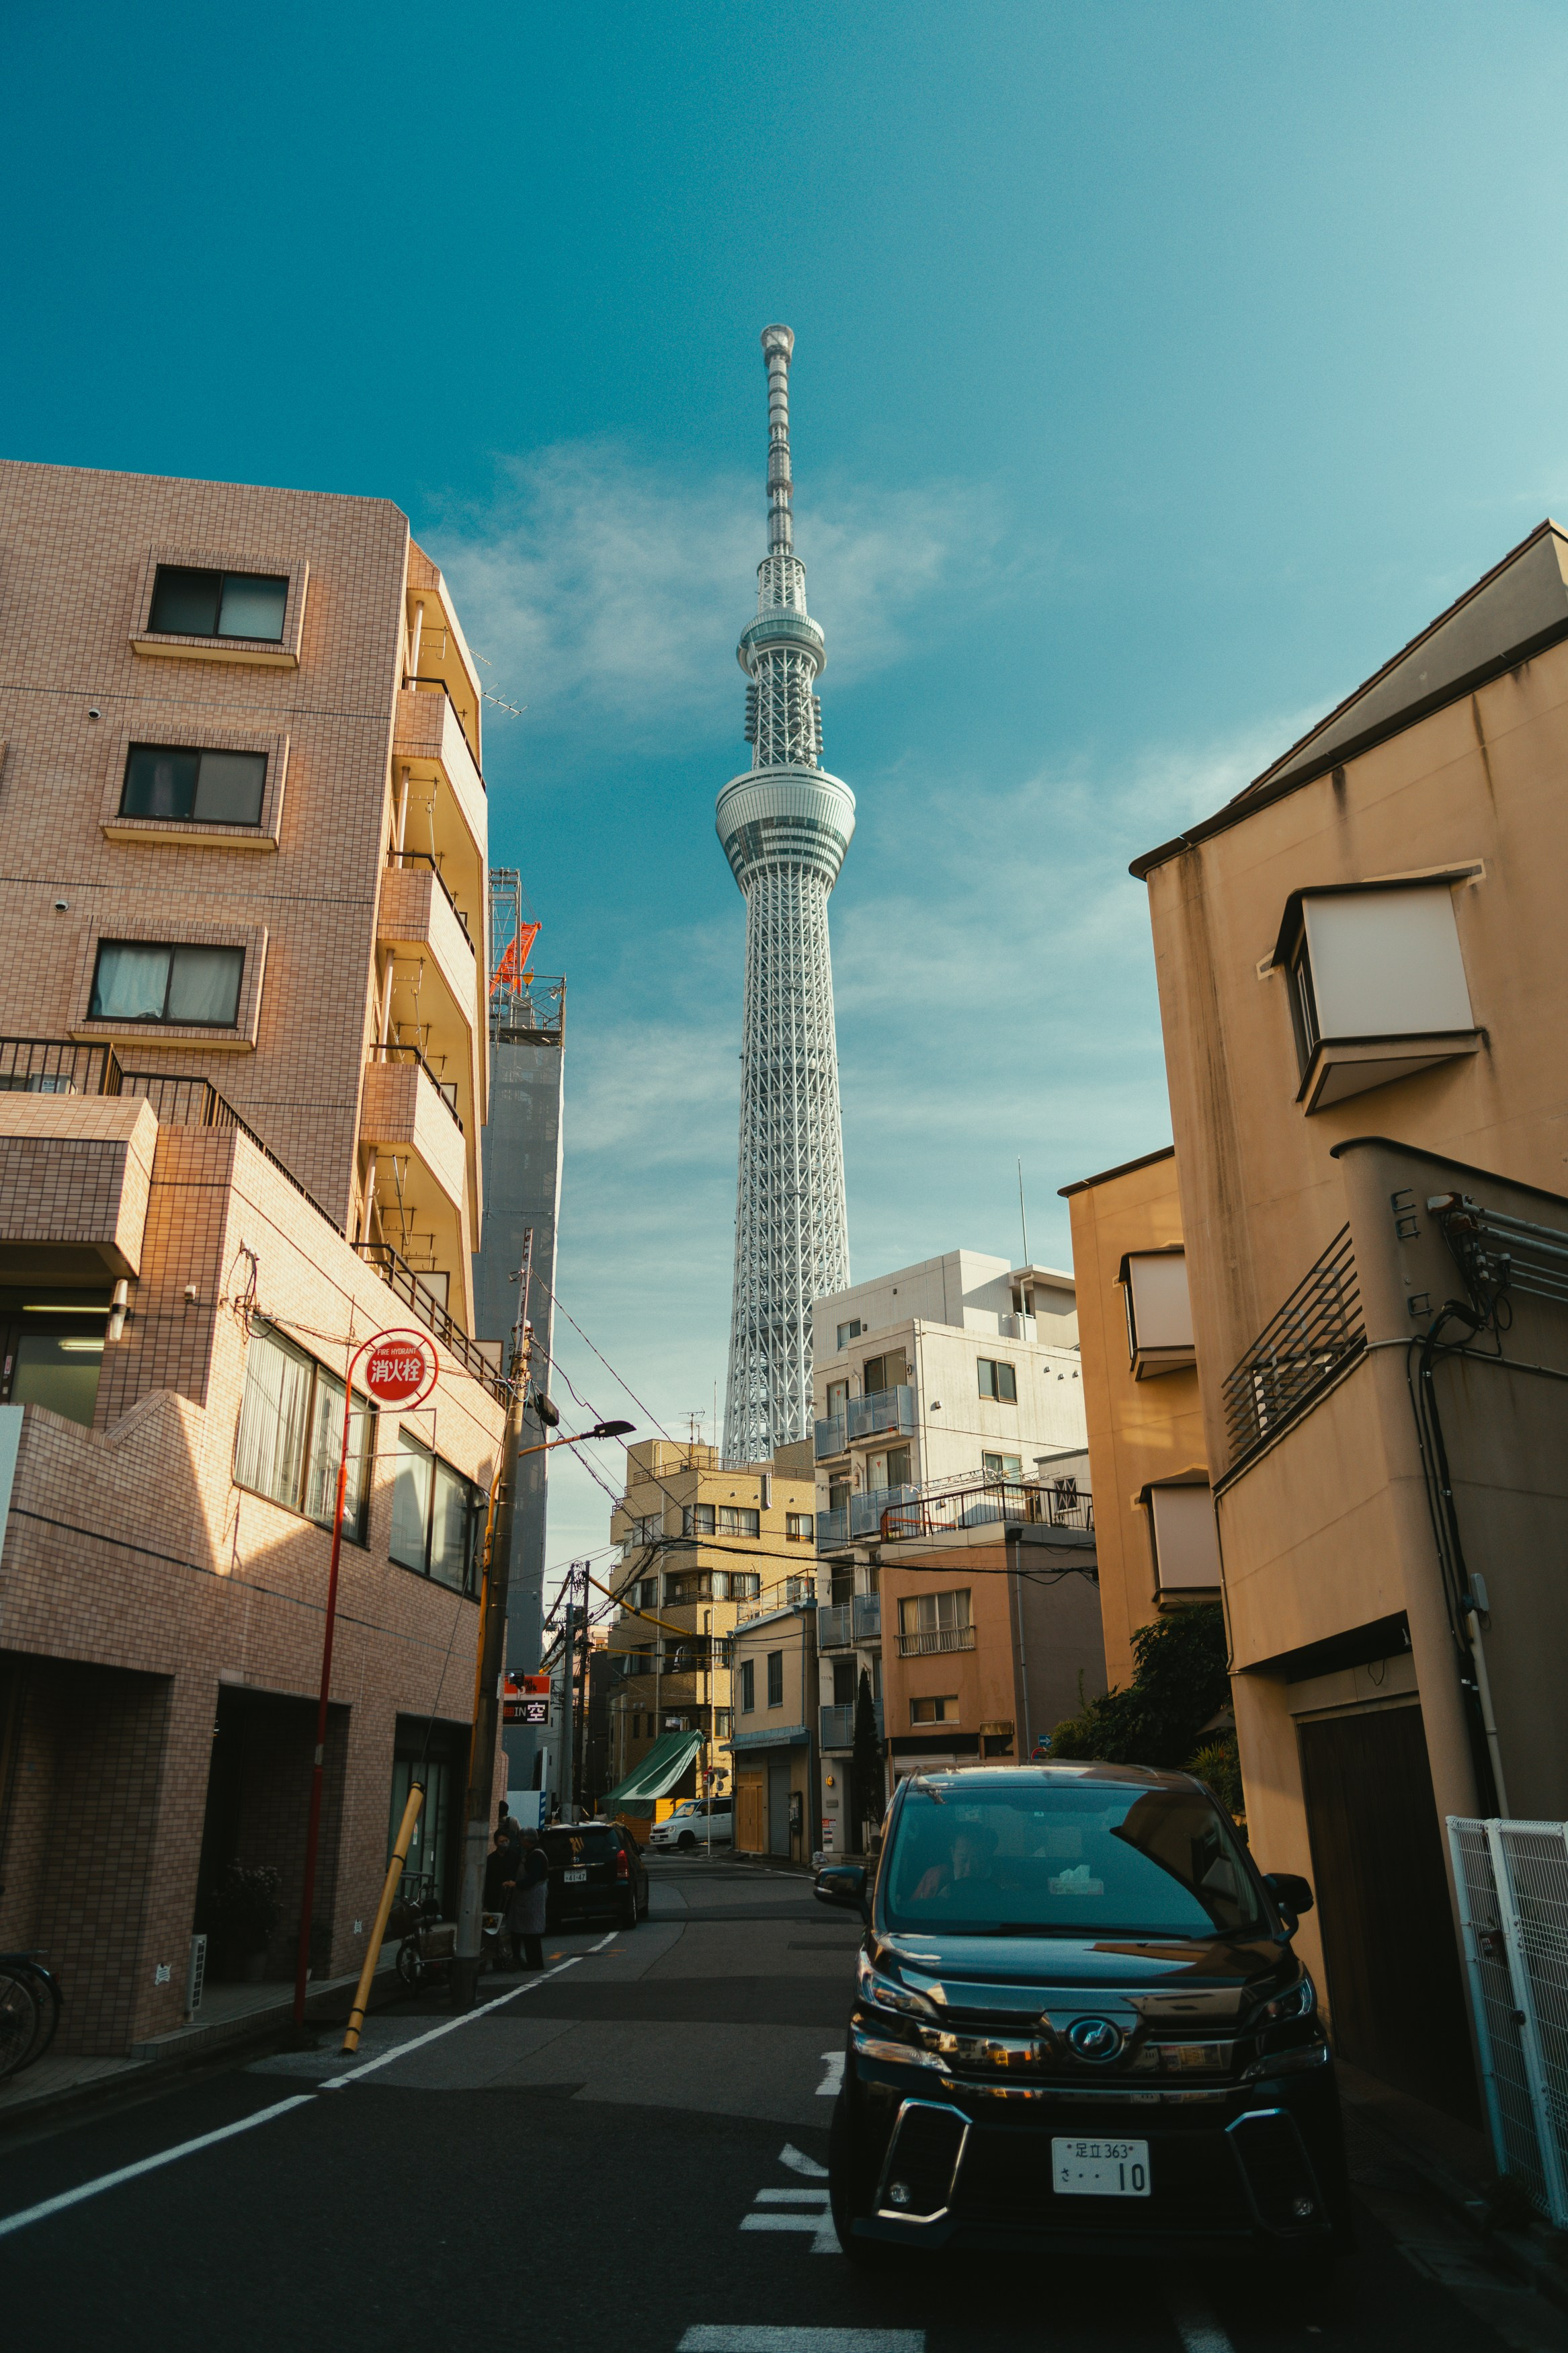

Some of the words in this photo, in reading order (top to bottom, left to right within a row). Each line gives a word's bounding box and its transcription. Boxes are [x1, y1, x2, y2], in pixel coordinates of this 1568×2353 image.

[371, 1358, 421, 1383] 消火栓
[514, 1707, 526, 1716] IN
[527, 1702, 546, 1721] 空
